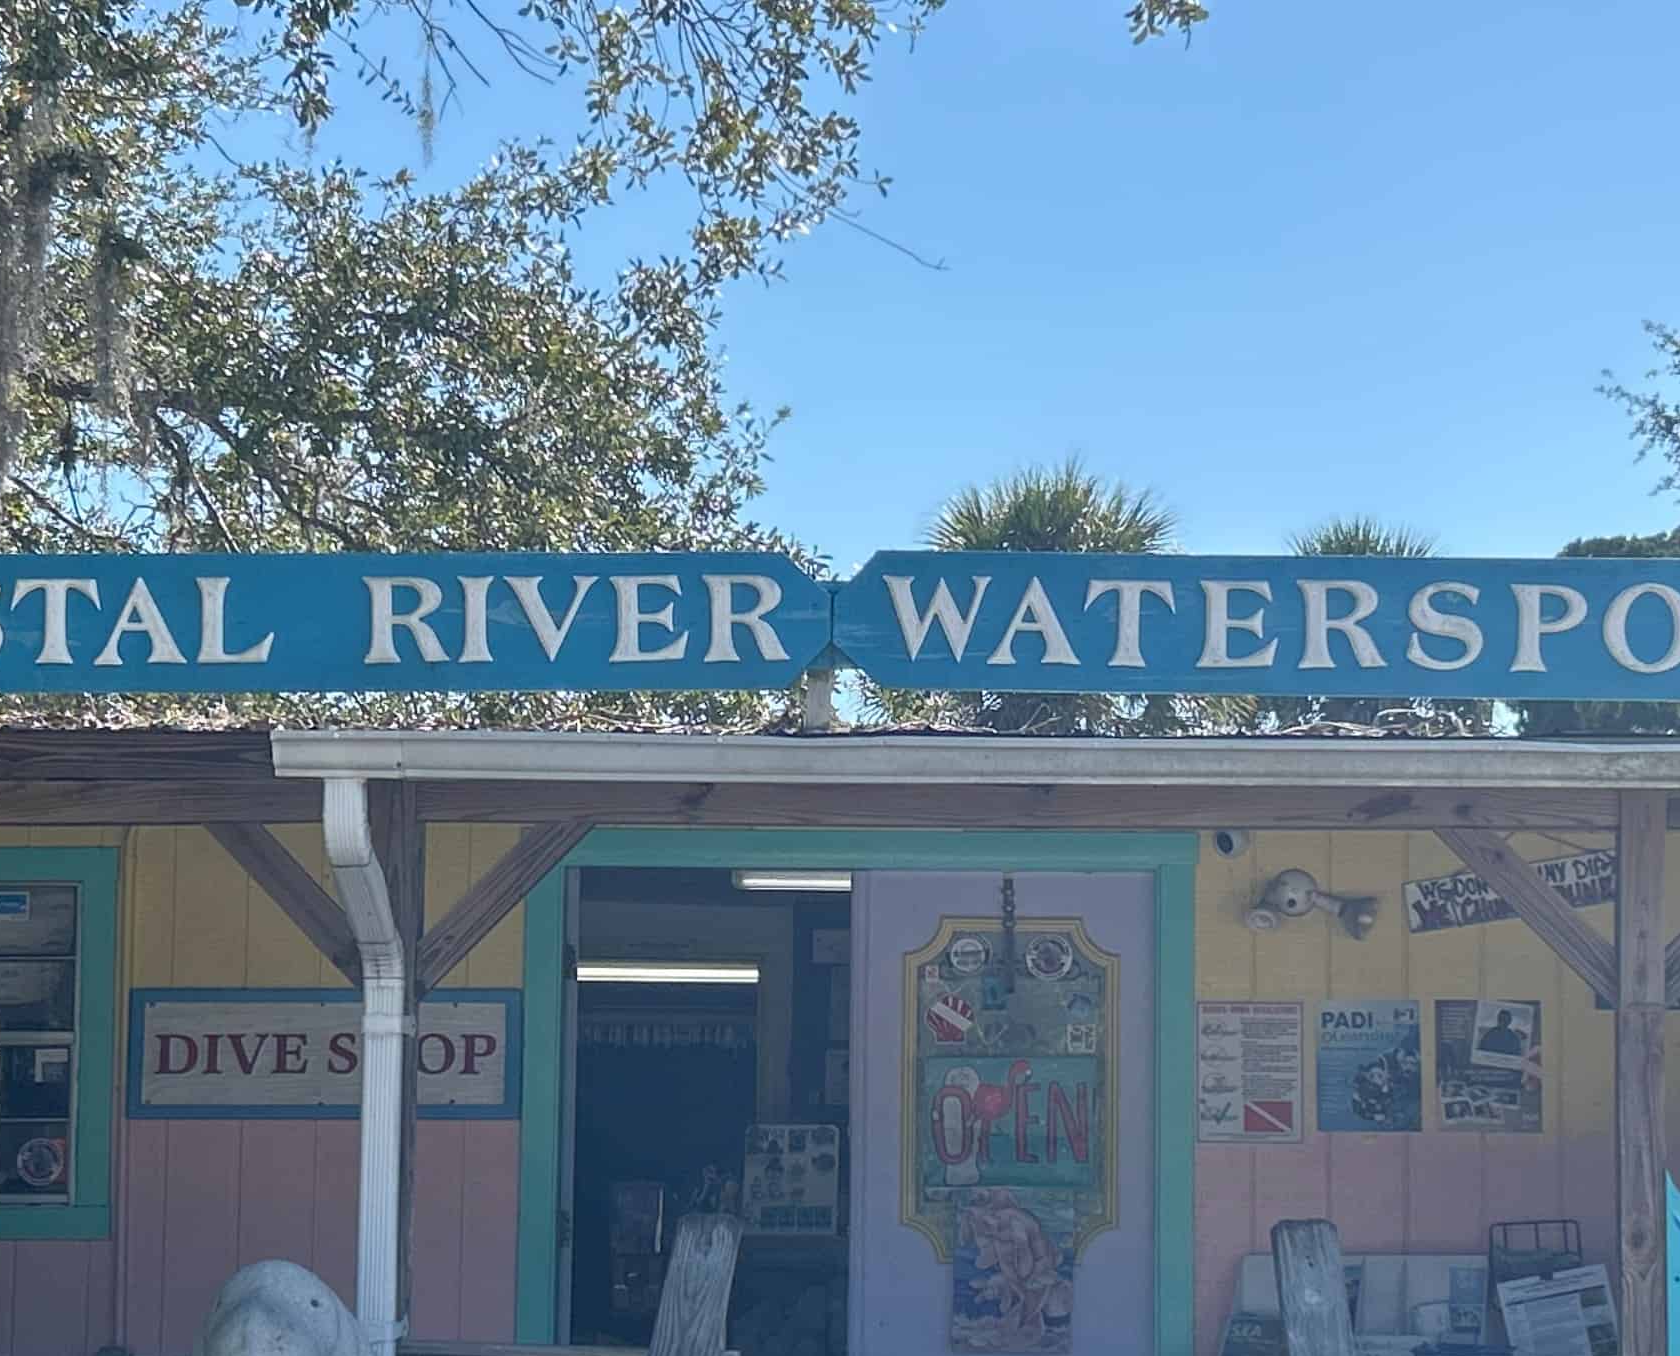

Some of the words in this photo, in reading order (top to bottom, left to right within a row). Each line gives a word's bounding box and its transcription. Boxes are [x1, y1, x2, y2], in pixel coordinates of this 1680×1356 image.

[363, 575, 791, 666] RIVER
[1322, 1011, 1374, 1030] PADI
[154, 1033, 309, 1075] DIVE
[327, 1032, 497, 1075] SOP
[931, 1080, 1090, 1165] OPEN
